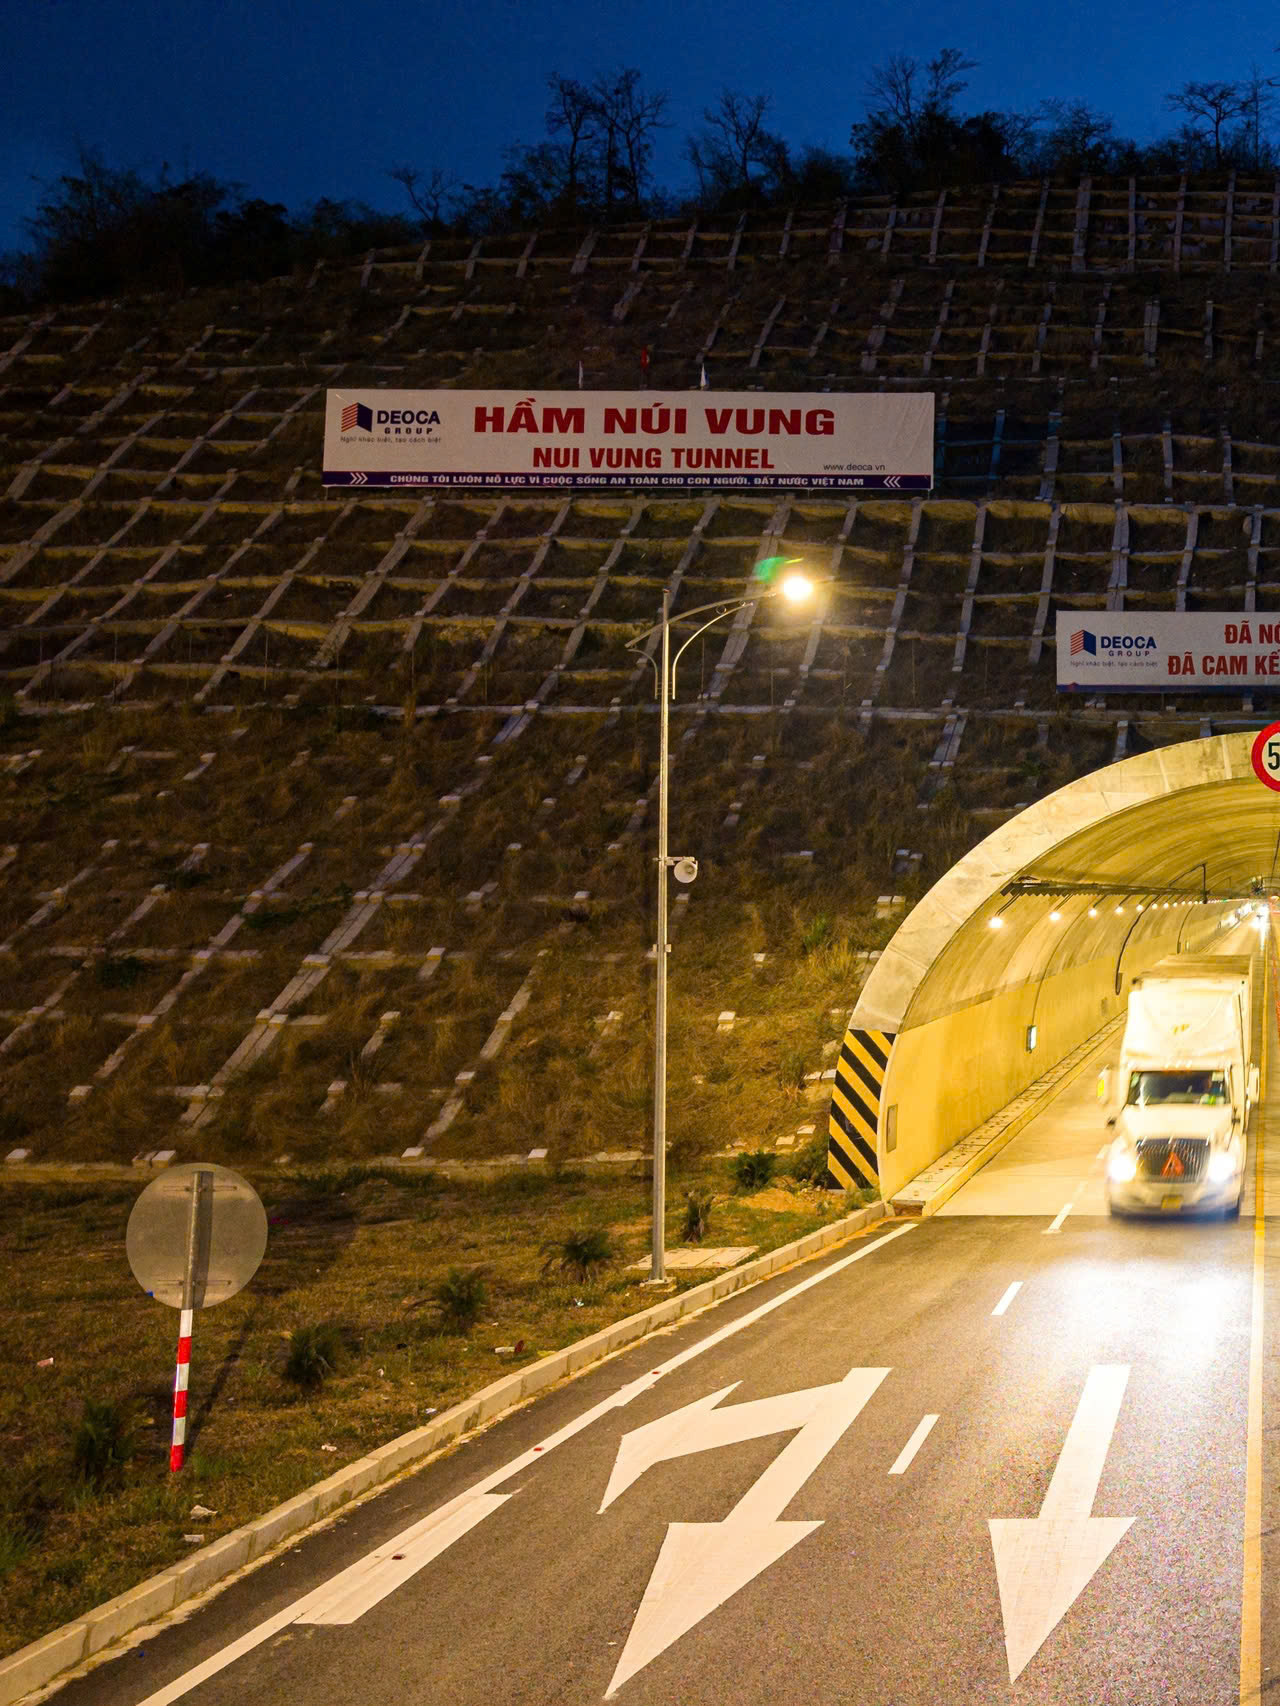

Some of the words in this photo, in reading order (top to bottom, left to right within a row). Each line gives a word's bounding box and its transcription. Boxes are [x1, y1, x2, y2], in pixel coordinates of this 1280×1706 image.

[377, 410, 441, 425] DEOCA
[474, 397, 585, 433] HẦM
[603, 402, 687, 434] NÚI
[704, 408, 835, 435] VUNG
[384, 427, 433, 435] GROUP
[532, 447, 580, 468] NUI
[589, 447, 662, 468] VUNG
[671, 448, 774, 469] TUNNEL
[823, 462, 886, 471] www.deocavn
[432, 474, 449, 483] TÔI
[453, 474, 482, 483] LUÔN
[576, 475, 607, 484] SỐNG
[629, 476, 658, 484] TOÀN
[661, 477, 684, 485] CHO
[687, 477, 710, 485] CON
[811, 477, 832, 486] VIỆT
[838, 477, 864, 485] NAM
[1224, 619, 1252, 644] ĐÃ
[1100, 635, 1157, 649] DEOCA
[1167, 651, 1196, 675] ĐÃ
[1202, 655, 1248, 675] CAM
